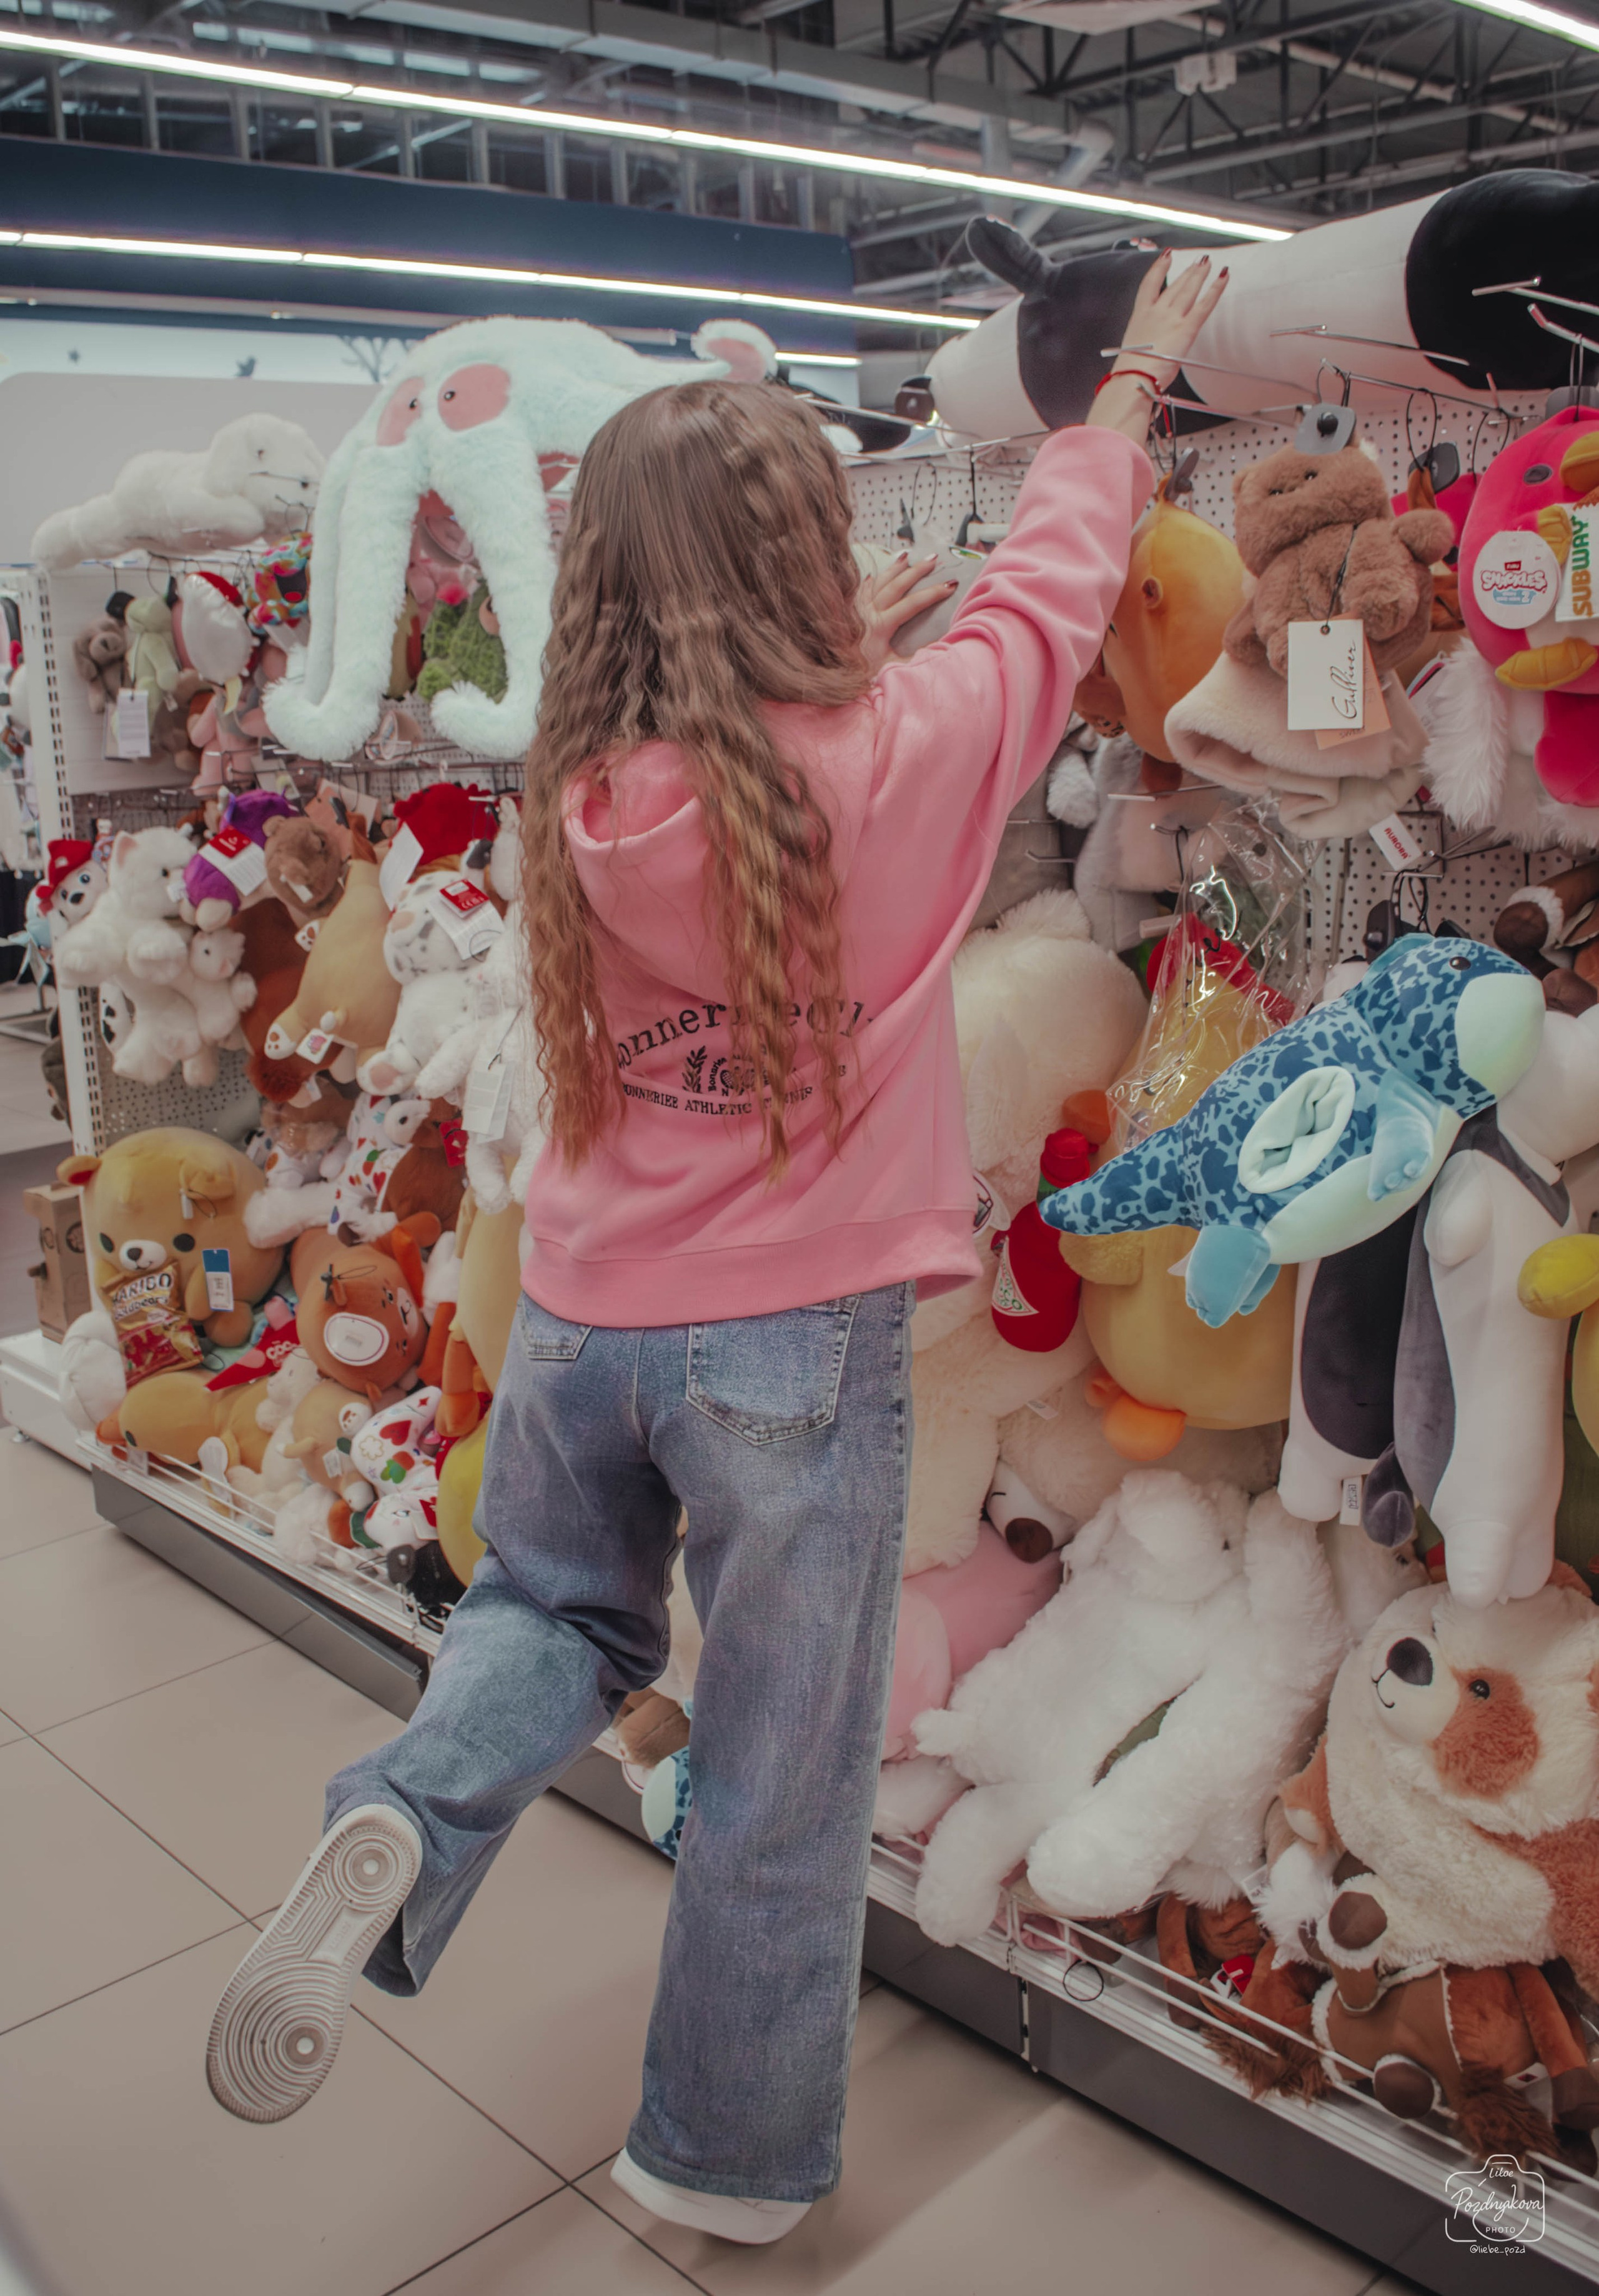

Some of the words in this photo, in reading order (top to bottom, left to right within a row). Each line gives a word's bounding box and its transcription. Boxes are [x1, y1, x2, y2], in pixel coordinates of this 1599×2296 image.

[1571, 515, 1593, 617] SUBWAY
[1330, 639, 1357, 718] Gulliver
[1384, 827, 1408, 859] AURORA
[685, 1100, 751, 1115] ATHLETIC
